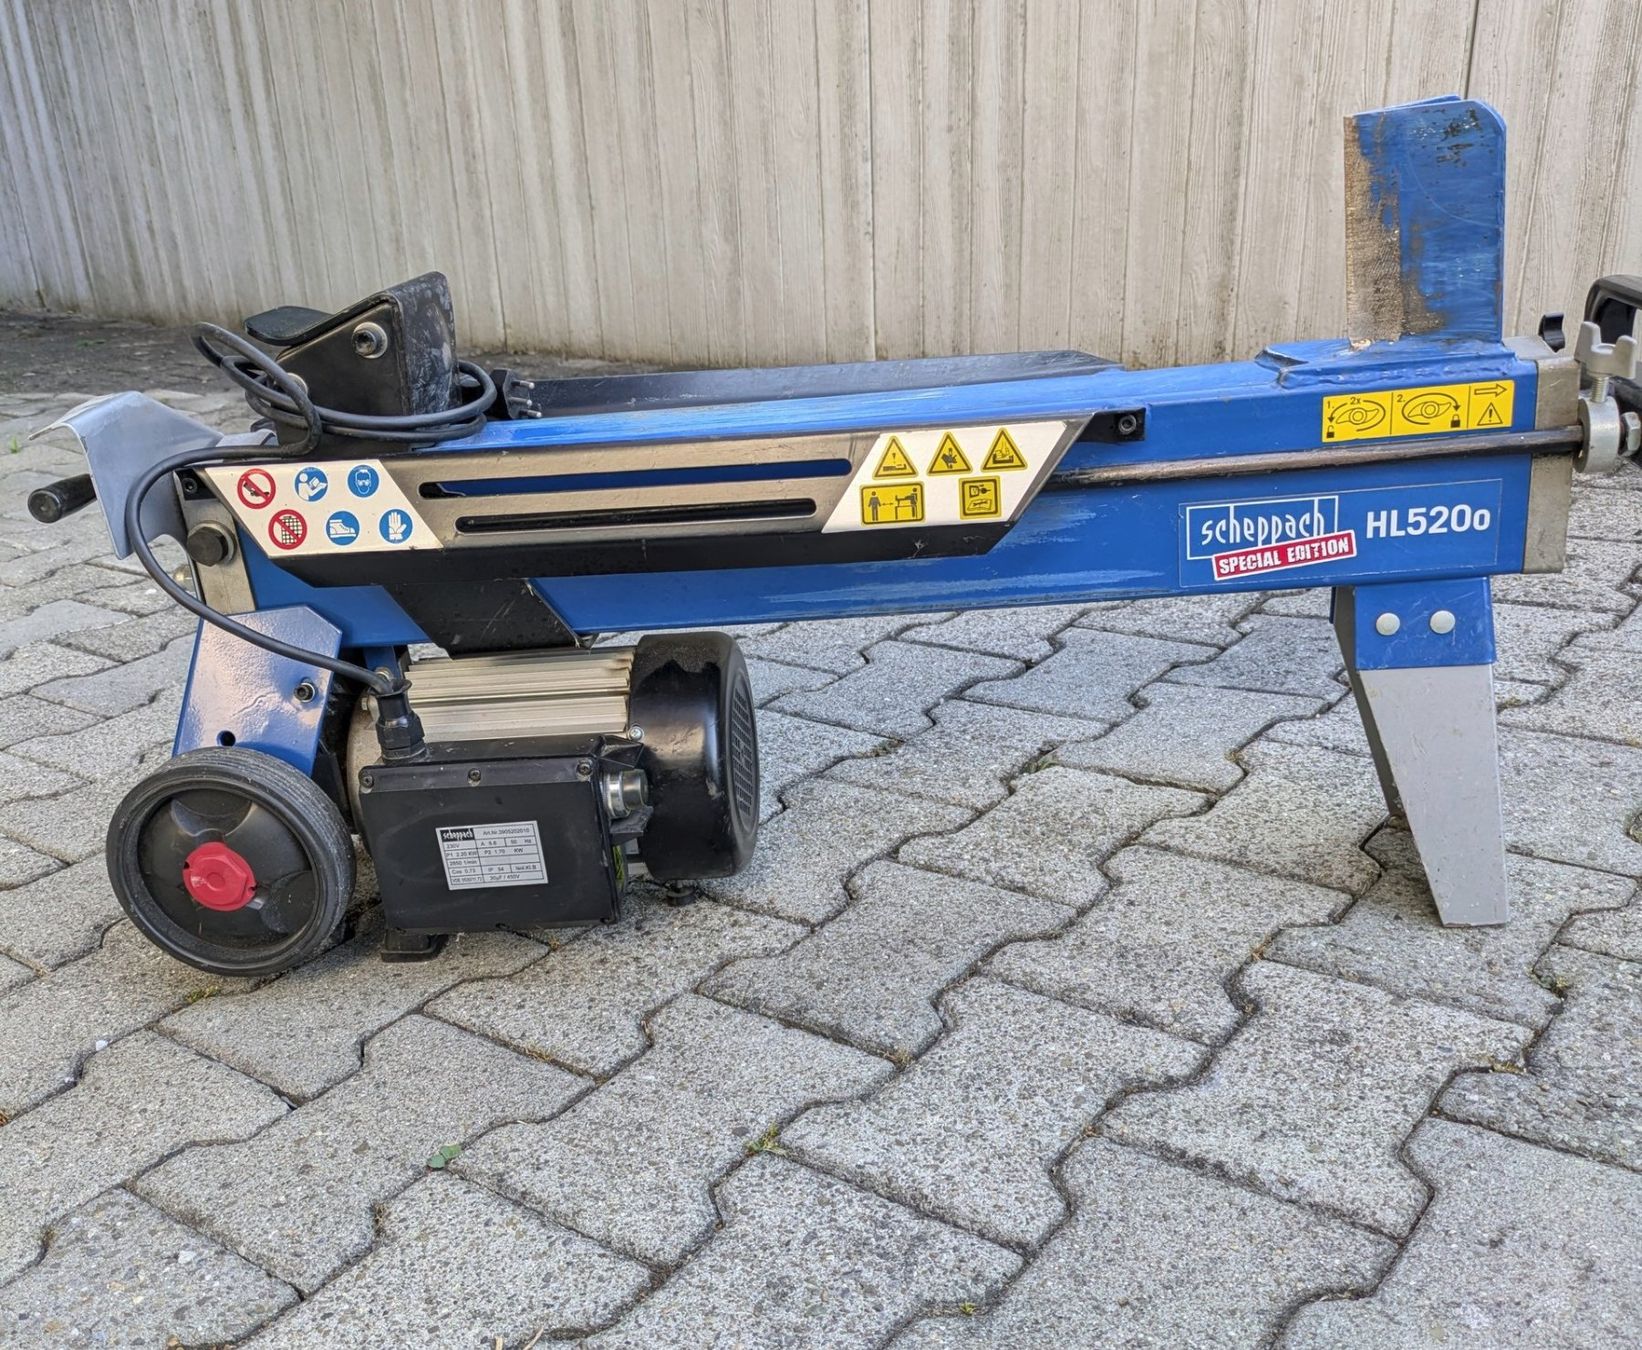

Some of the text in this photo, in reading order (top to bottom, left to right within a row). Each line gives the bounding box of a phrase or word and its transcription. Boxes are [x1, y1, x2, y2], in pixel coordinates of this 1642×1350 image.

[1350, 397, 1361, 405] 2x
[1396, 394, 1406, 403] 2.
[1201, 497, 1325, 546] scheppach
[1218, 538, 1350, 575] SPECIAL EDITION
[442, 828, 474, 841] scheppach
